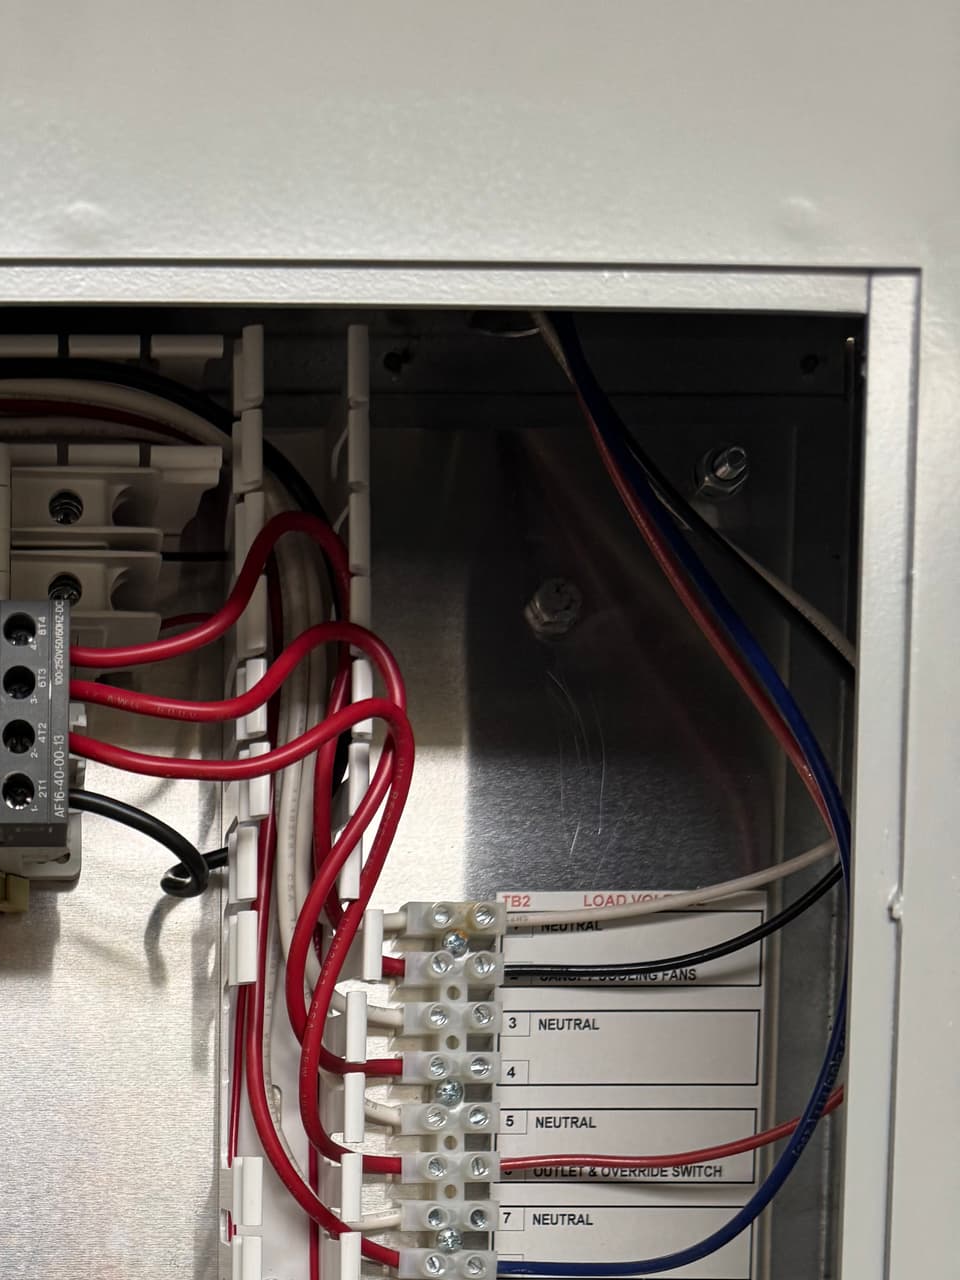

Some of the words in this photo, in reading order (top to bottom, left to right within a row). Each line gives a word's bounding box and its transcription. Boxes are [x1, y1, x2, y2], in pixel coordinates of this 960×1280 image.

[502, 895, 531, 907] TB2
[583, 895, 628, 907] LOAD
[662, 969, 697, 981] FANS
[508, 1017, 517, 1029] 3
[538, 1018, 600, 1031] NEUTRAL
[506, 1067, 516, 1078] 4
[505, 1115, 514, 1127] 5
[536, 1116, 597, 1129] NEUTRAL
[533, 1166, 584, 1177] OUTLET
[588, 1166, 597, 1177] &
[601, 1166, 667, 1178] OVERRIDE
[672, 1165, 723, 1177] SWITCH
[503, 1212, 511, 1224] 7
[532, 1213, 594, 1226] NEUTRAL
